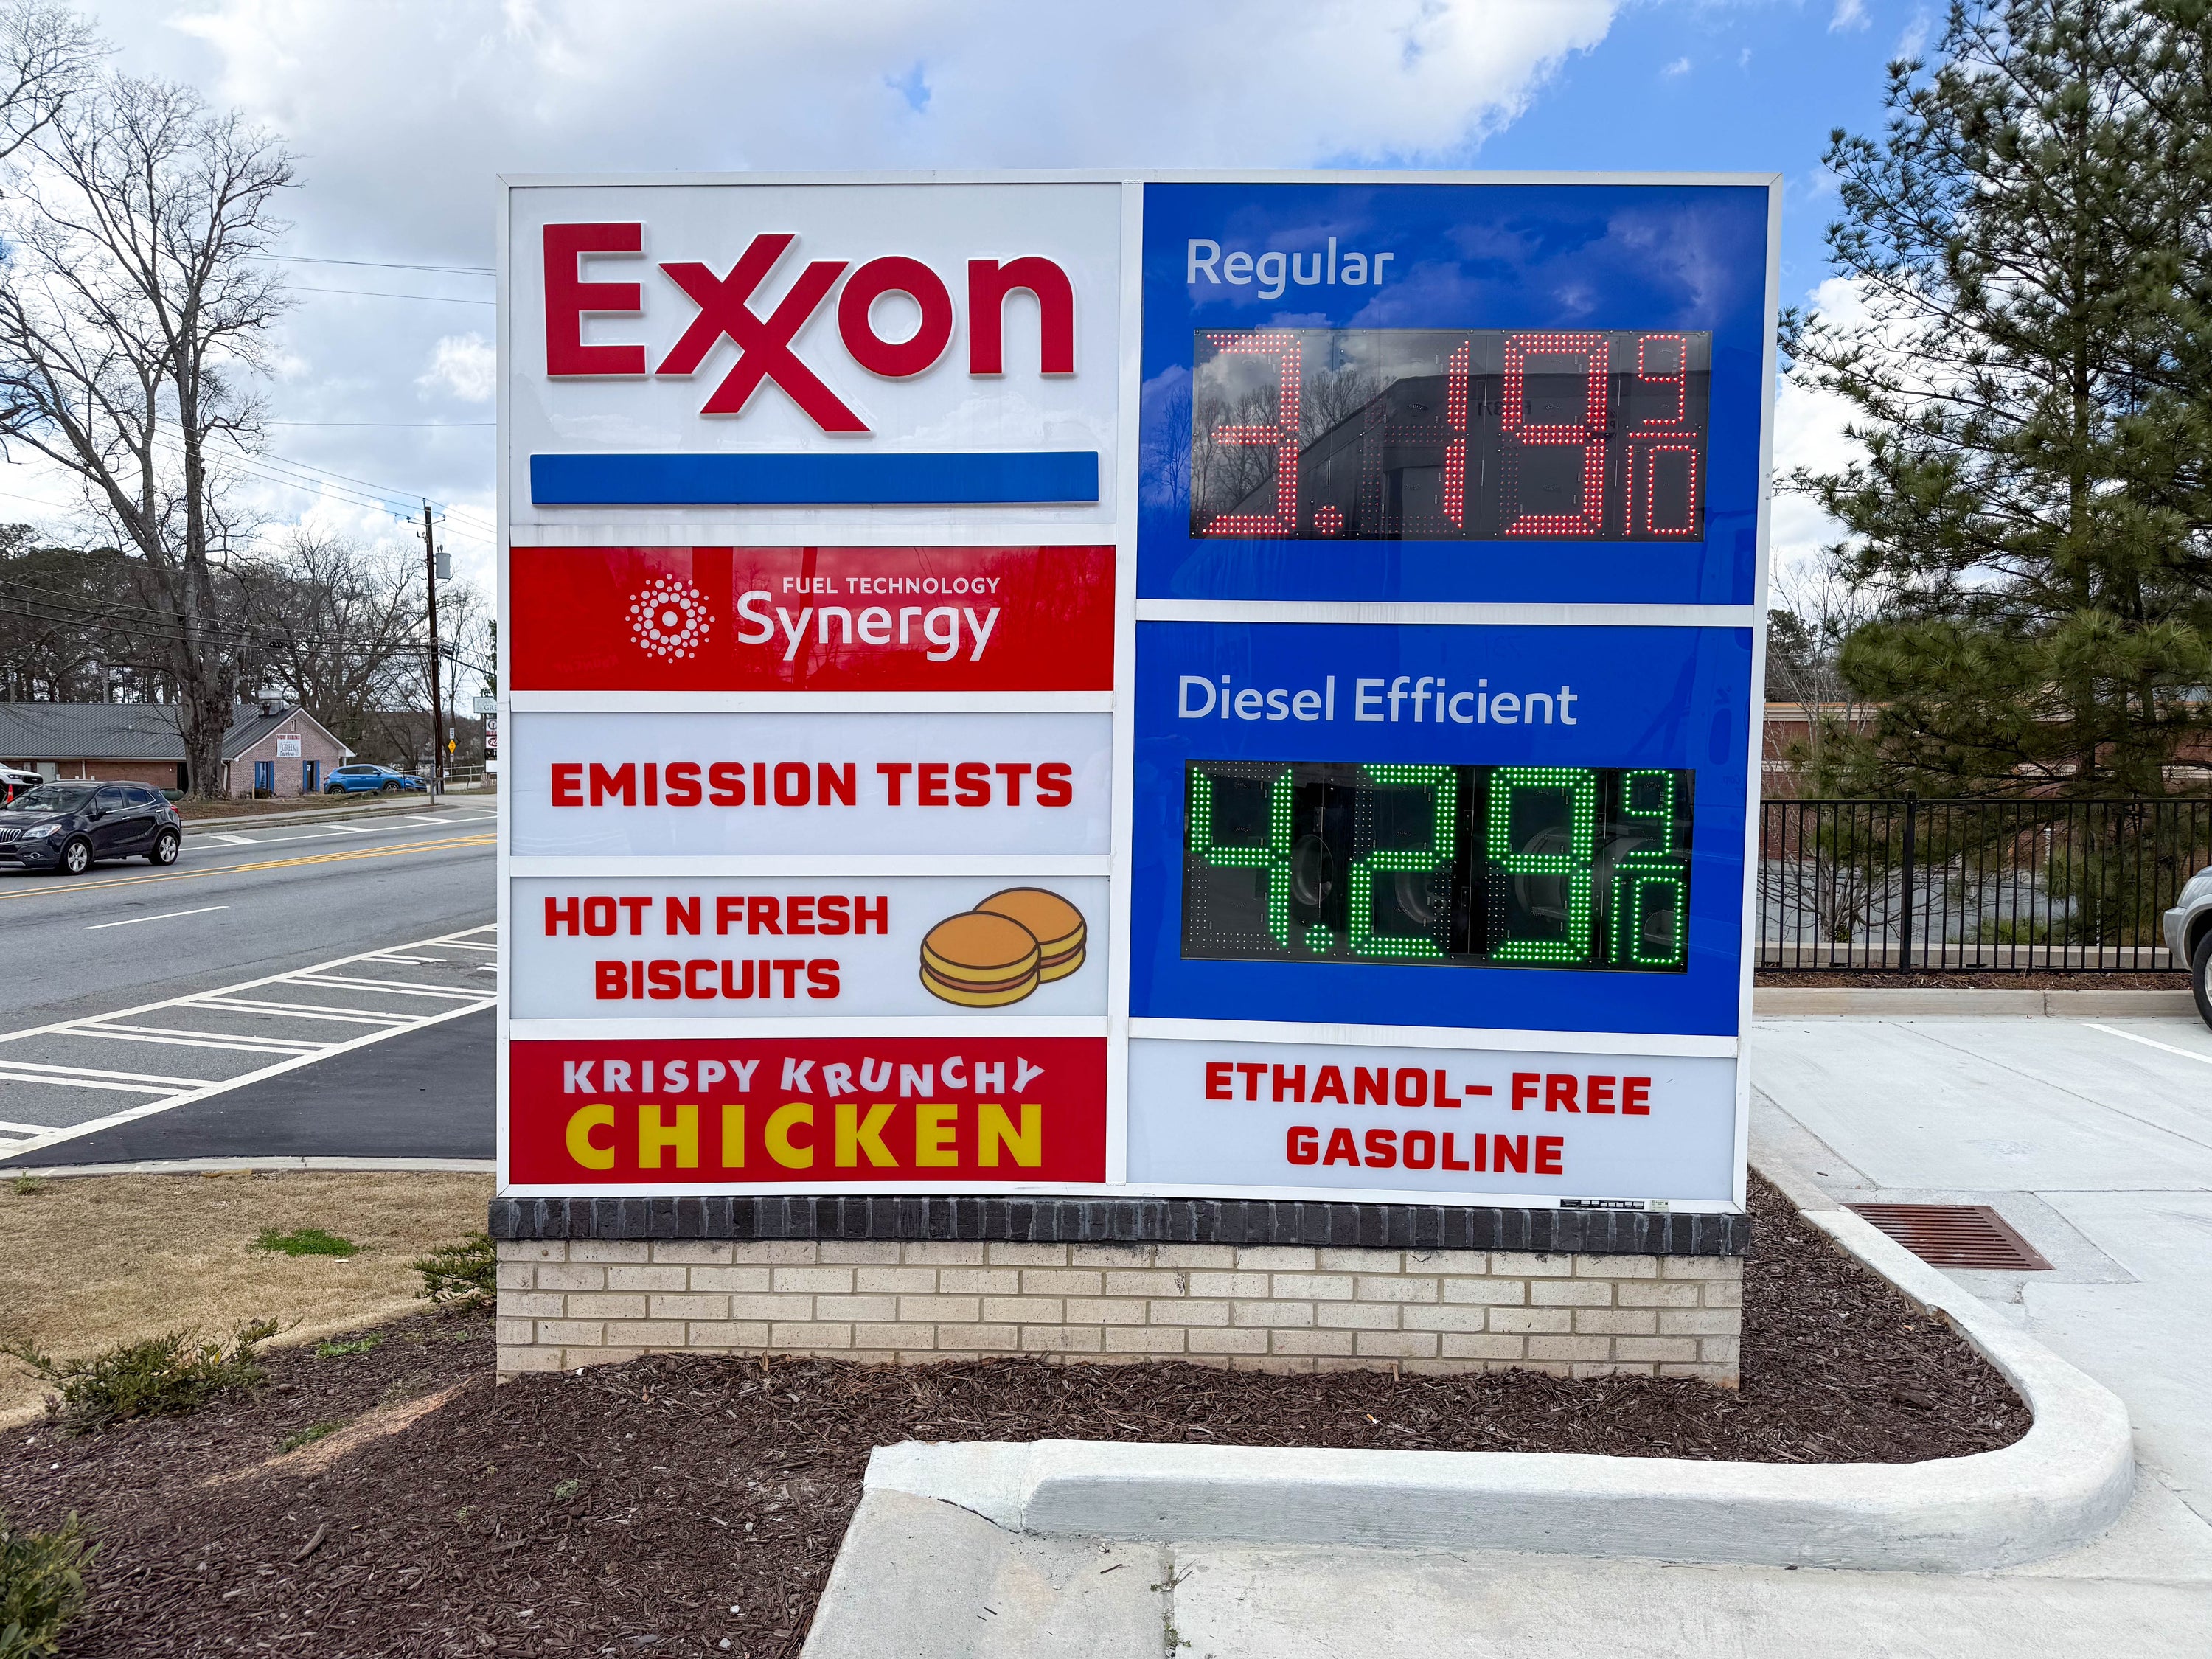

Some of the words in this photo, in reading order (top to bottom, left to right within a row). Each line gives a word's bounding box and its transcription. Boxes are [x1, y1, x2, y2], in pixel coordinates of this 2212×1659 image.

[1188, 237, 1393, 299] Regular
[543, 222, 1074, 432] Exxon
[1203, 333, 1610, 535] 3.19
[783, 577, 838, 593] FUEL
[845, 577, 1000, 594] TECHNOLOGY
[737, 590, 1001, 662] Synergy
[1178, 675, 1335, 720] Diesel
[1354, 676, 1578, 725] Efficient
[551, 762, 856, 807] EMISSION
[876, 762, 1073, 807] TESTS
[1190, 764, 1596, 962] 4.29
[544, 896, 653, 936] HOT
[666, 896, 701, 936] N
[716, 895, 888, 936] FRESH
[595, 959, 840, 1000] BISCUITS
[563, 1059, 760, 1093] KRISPY
[780, 1055, 1046, 1098] KRUNCHY
[1512, 1072, 1652, 1116] FREE
[566, 1103, 1042, 1170] CHICKEN
[1287, 1126, 1564, 1175] GASOLINE
